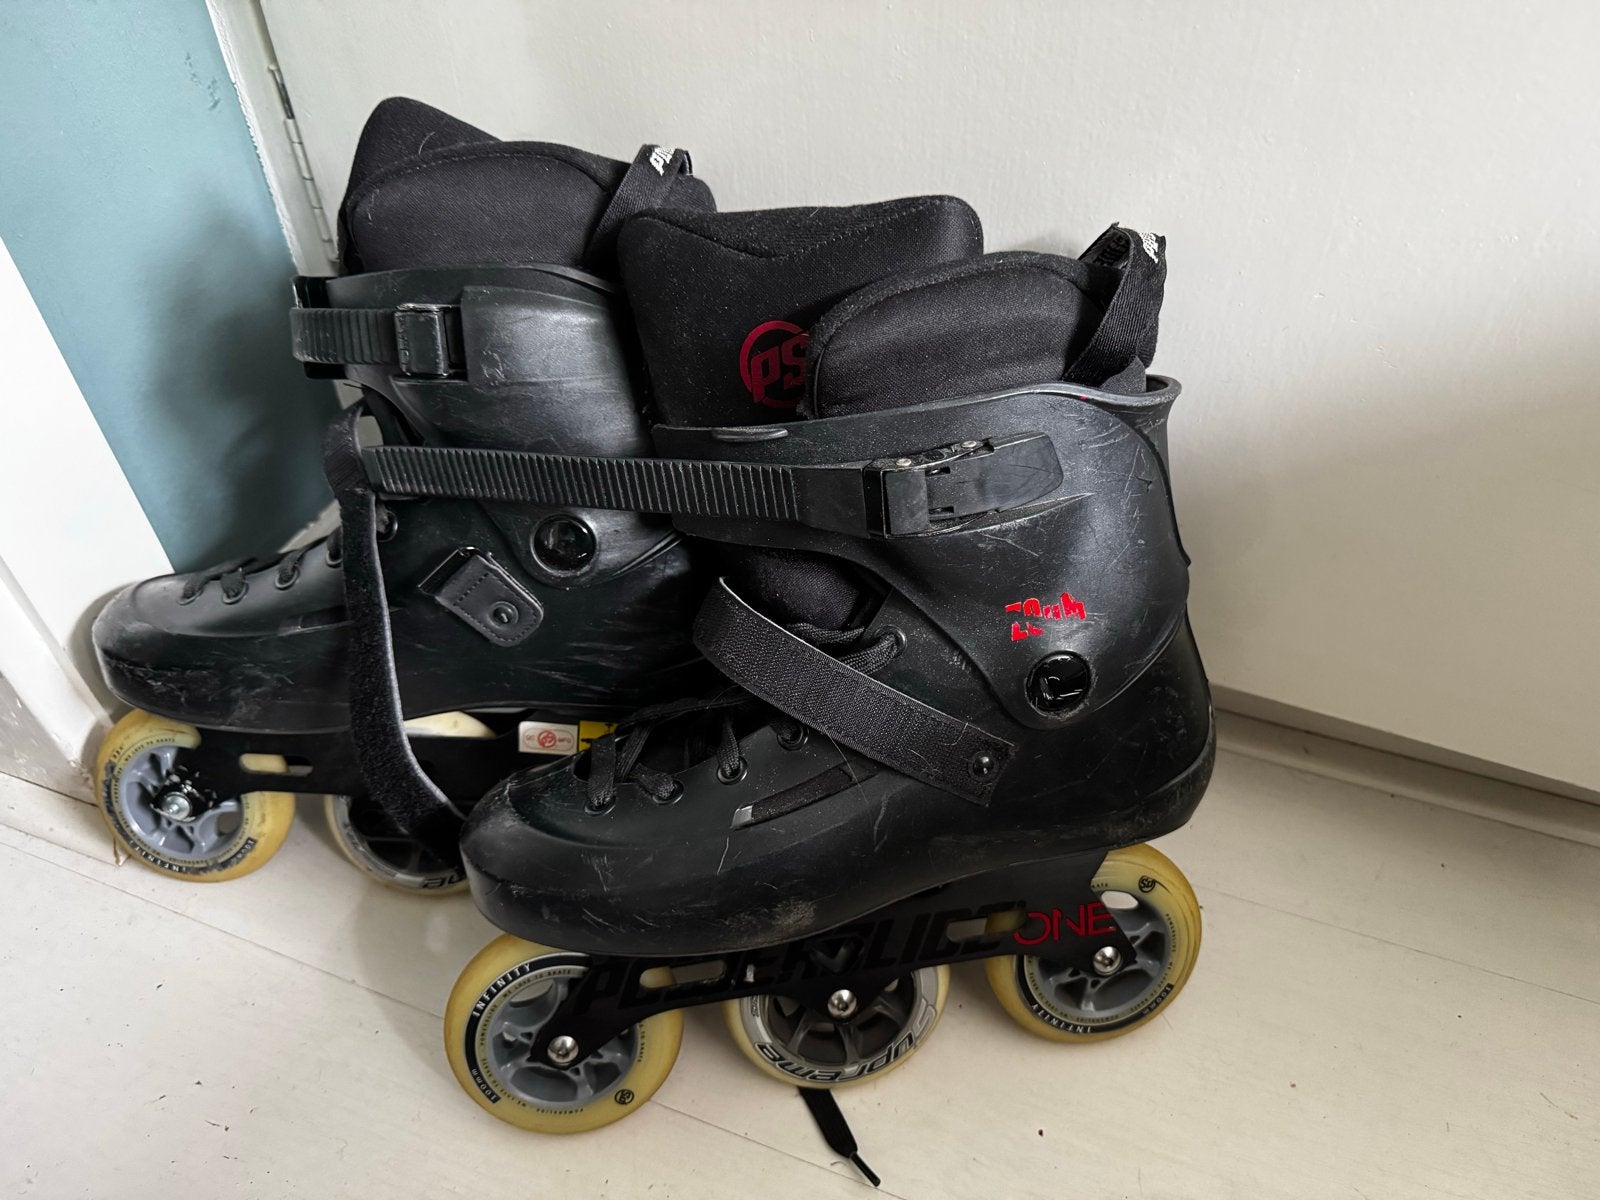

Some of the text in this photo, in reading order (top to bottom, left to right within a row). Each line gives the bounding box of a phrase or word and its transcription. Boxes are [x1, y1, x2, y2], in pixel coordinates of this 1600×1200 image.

[1013, 902, 1116, 945] ONE
[471, 962, 532, 1017] INFINITY
[1030, 1001, 1090, 1032] INFINITY
